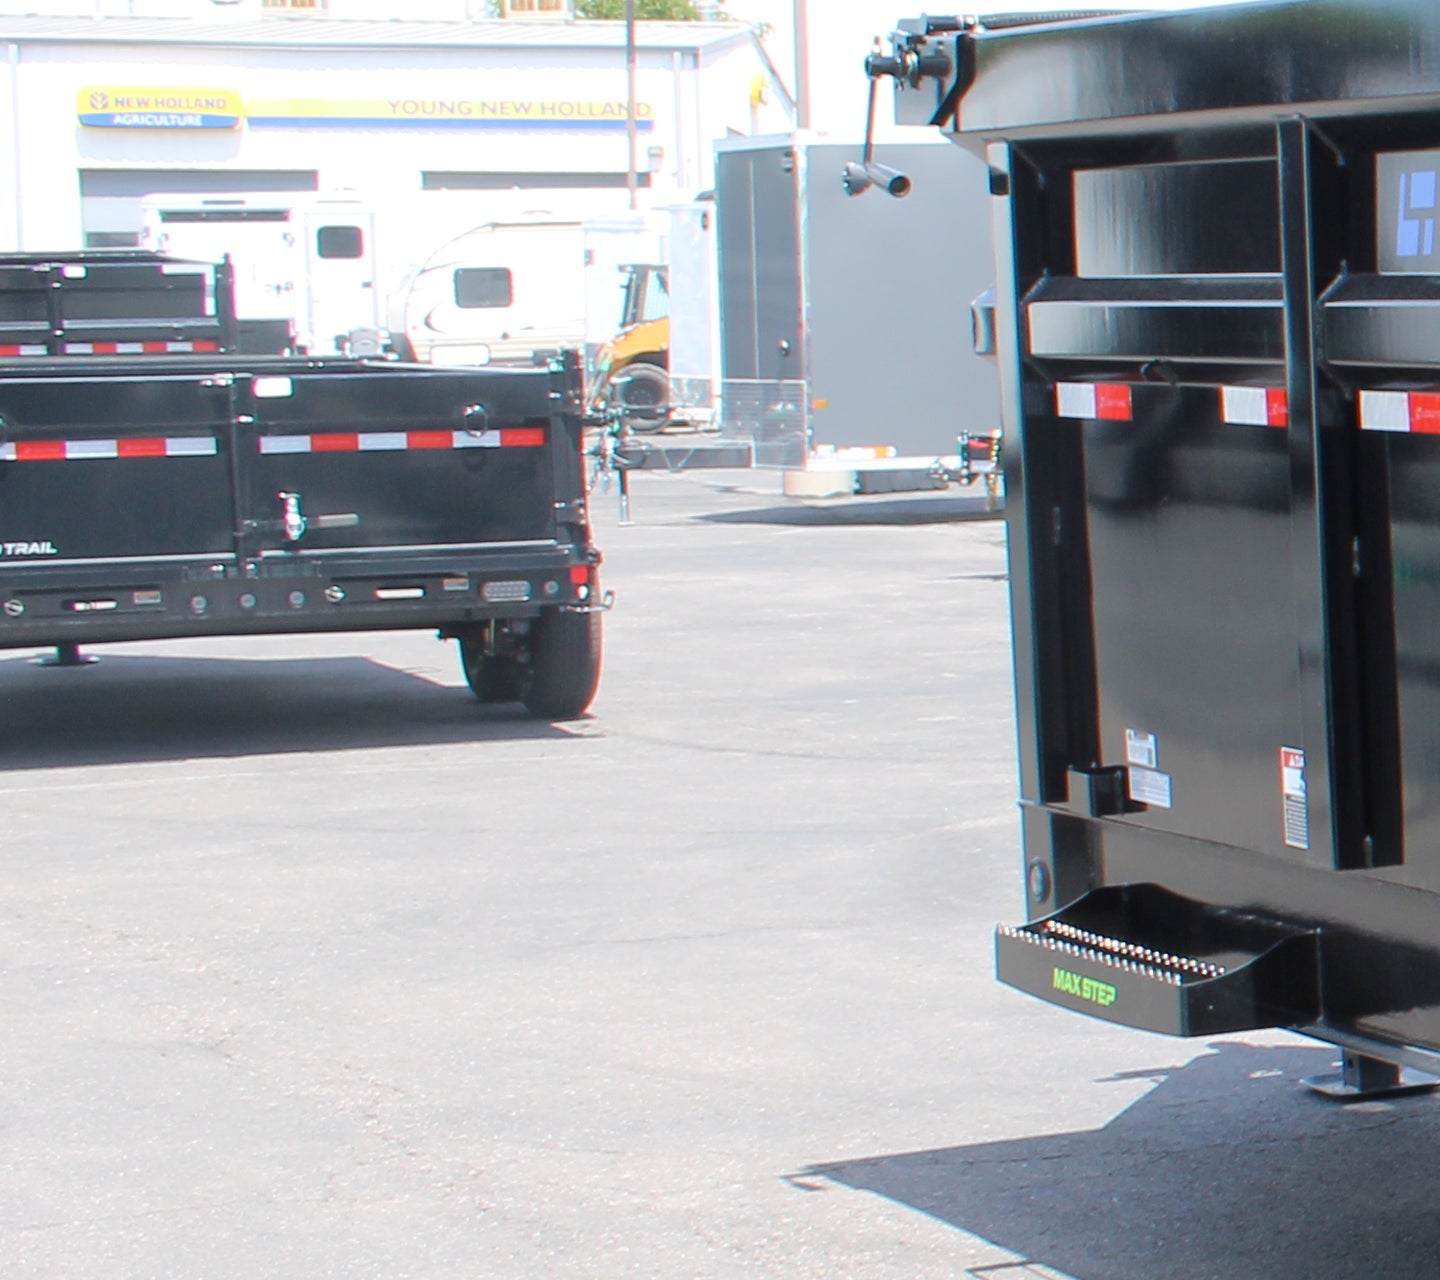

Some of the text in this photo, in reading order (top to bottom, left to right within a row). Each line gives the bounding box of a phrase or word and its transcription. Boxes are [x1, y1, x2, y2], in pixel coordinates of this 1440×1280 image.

[114, 97, 227, 108] NEW HOLLAND
[387, 100, 651, 117] YOUNG NEW HOLLAND
[113, 114, 202, 126] AGRICULTURE
[4, 541, 58, 555] TRAIL
[1053, 967, 1116, 1007] MAX STEP
